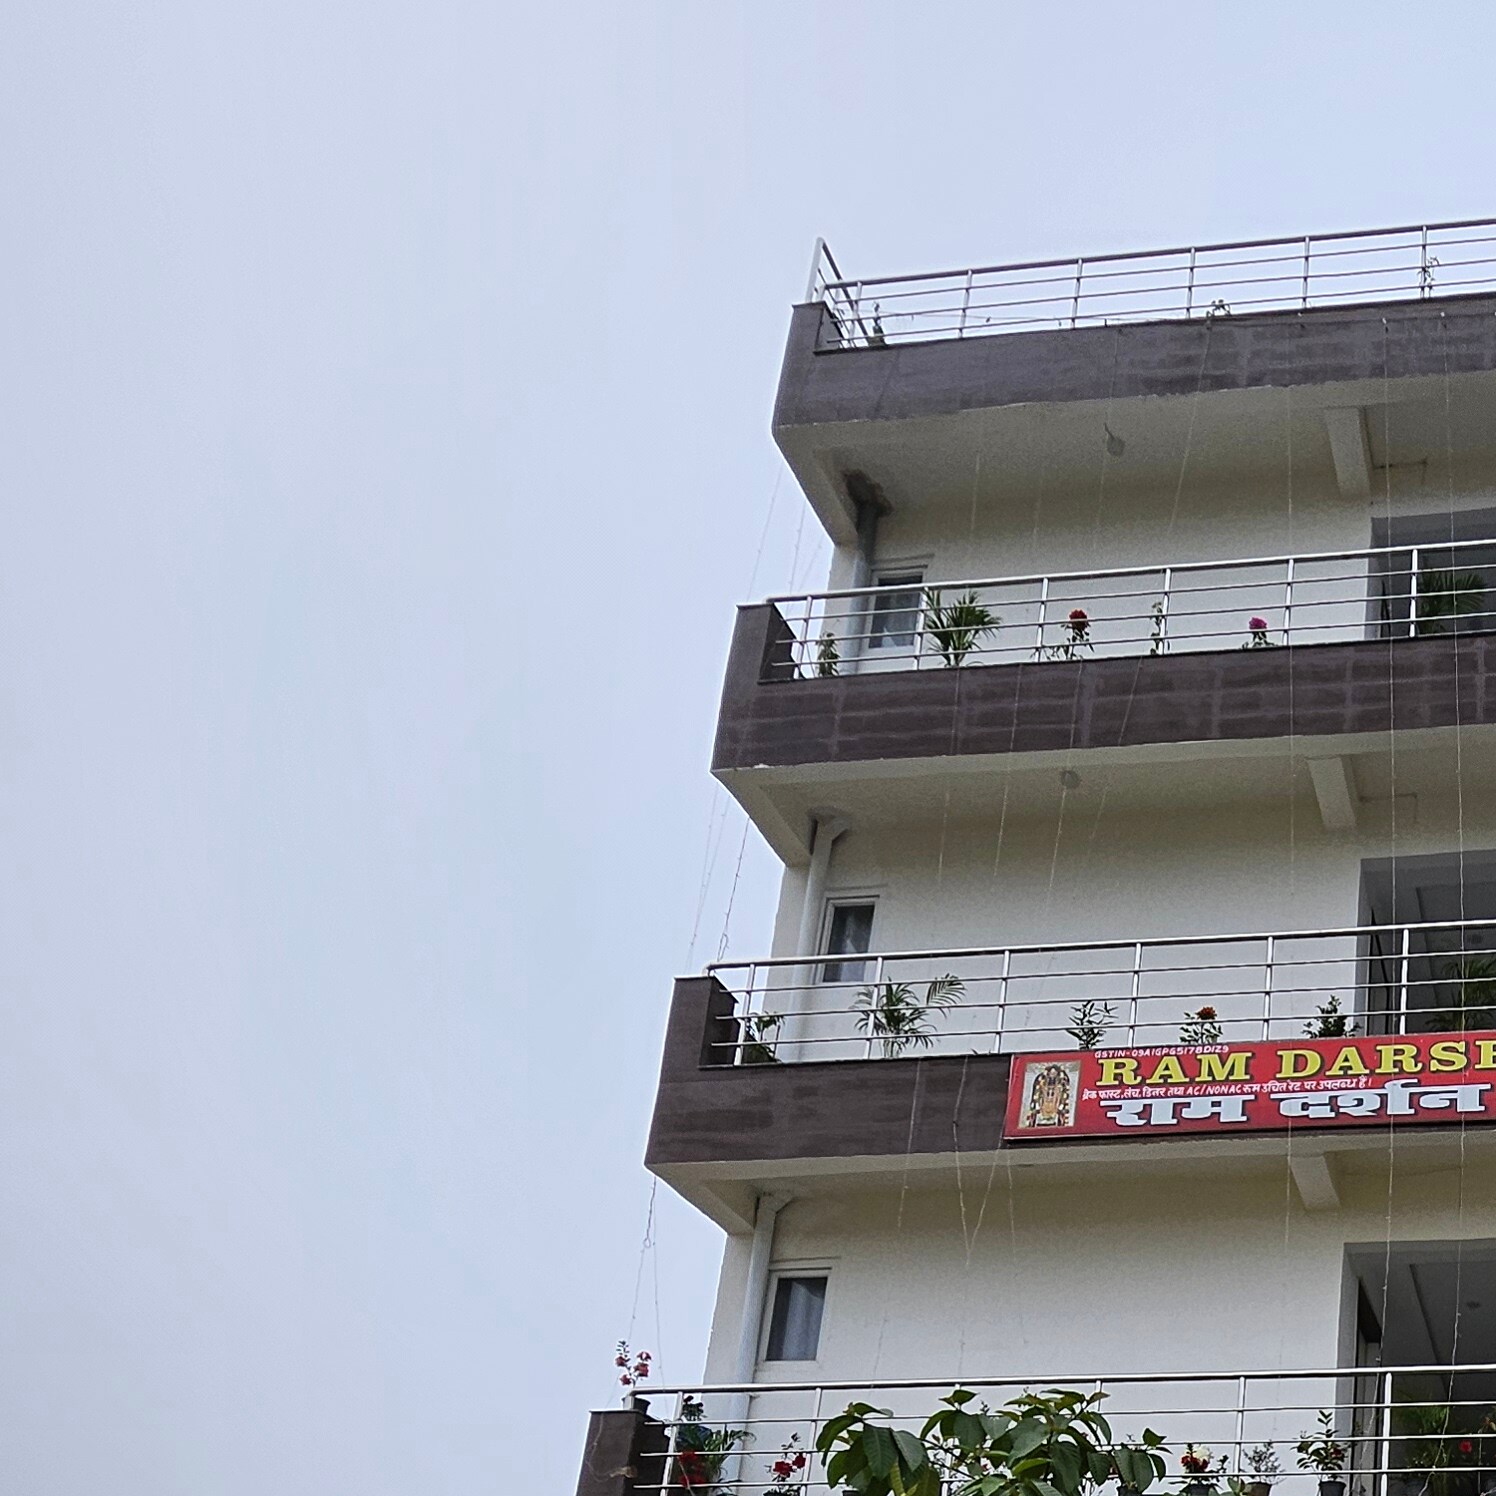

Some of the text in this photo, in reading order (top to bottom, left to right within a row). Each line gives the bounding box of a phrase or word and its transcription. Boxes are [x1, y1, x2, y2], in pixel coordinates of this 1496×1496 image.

[1095, 1052, 1253, 1086] RAM
[1261, 1080, 1287, 1093] उचित
[1287, 1079, 1301, 1092] रेट
[1304, 1080, 1317, 1091] पर
[1099, 1094, 1255, 1126] राम
[1270, 1078, 1492, 1118] दर्शन
